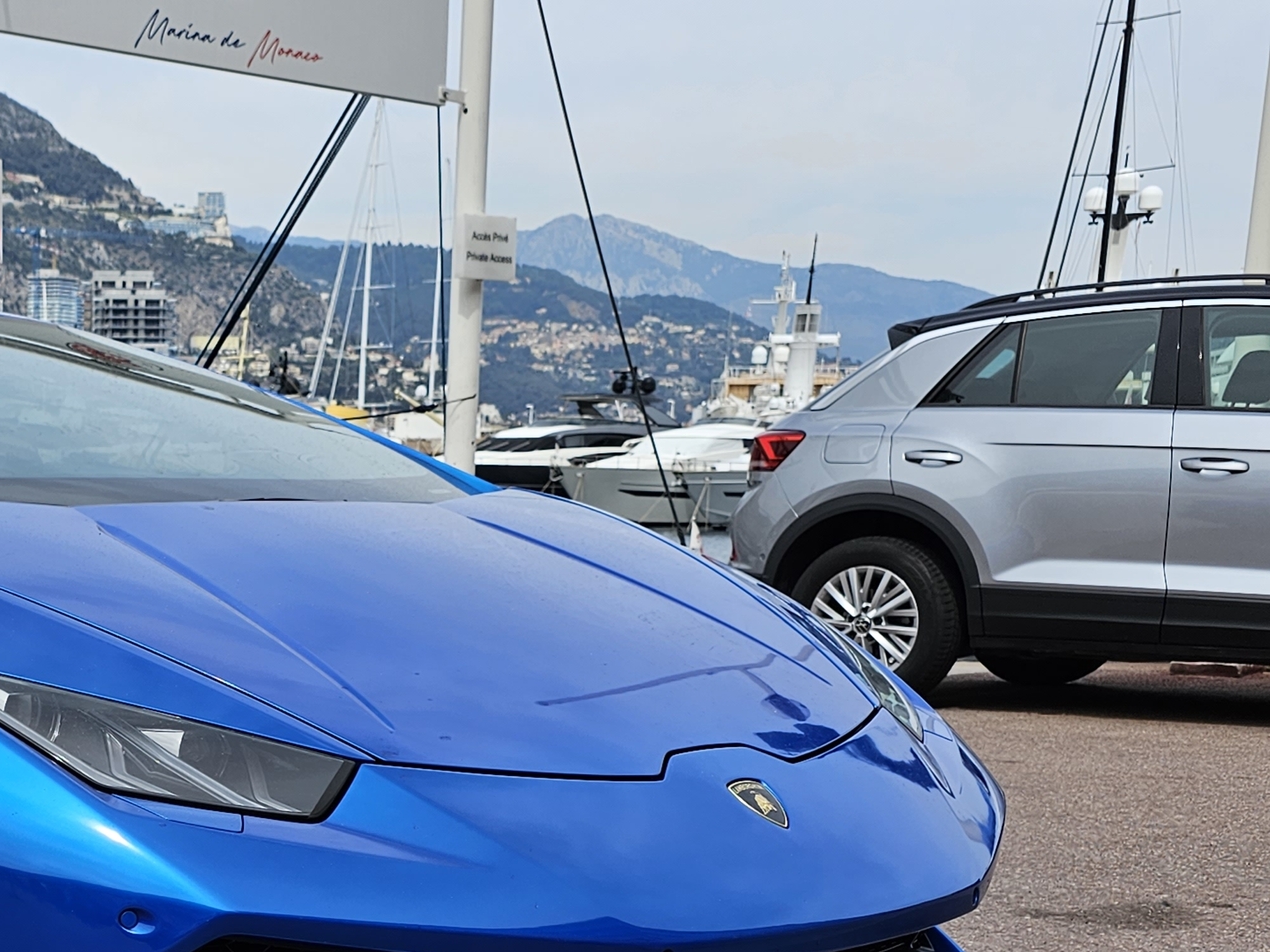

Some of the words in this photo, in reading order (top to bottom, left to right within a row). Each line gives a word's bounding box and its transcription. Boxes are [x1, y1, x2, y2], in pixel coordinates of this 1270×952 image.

[134, 9, 215, 48] Marina
[220, 31, 246, 48] de
[247, 30, 323, 68] Monaco
[466, 251, 488, 262] Private
[490, 253, 512, 264] Access
